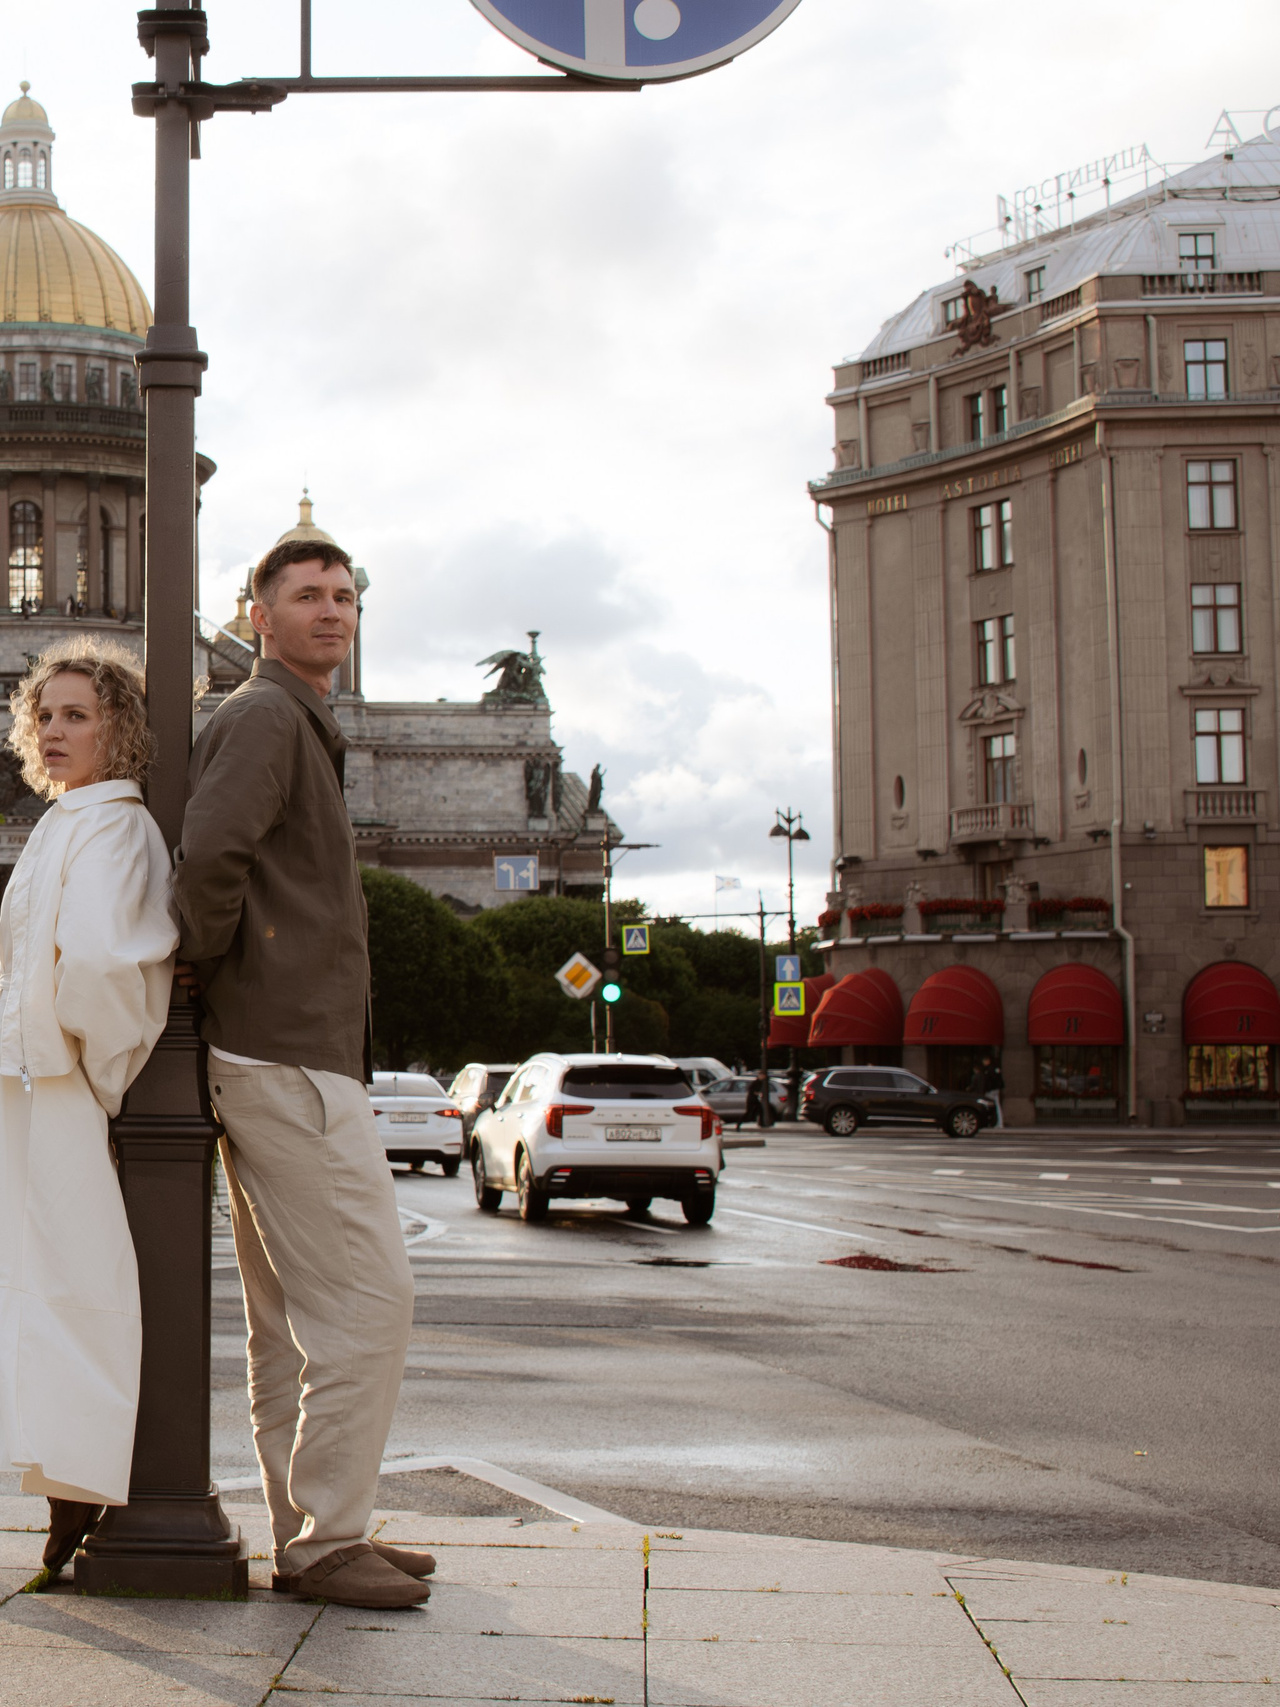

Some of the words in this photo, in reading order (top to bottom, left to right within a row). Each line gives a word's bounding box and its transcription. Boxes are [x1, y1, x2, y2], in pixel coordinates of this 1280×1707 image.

[1014, 142, 1151, 210] ГОСТИНИЦА
[941, 465, 1021, 500] ASTORIA
[867, 493, 908, 515] HOTEL
